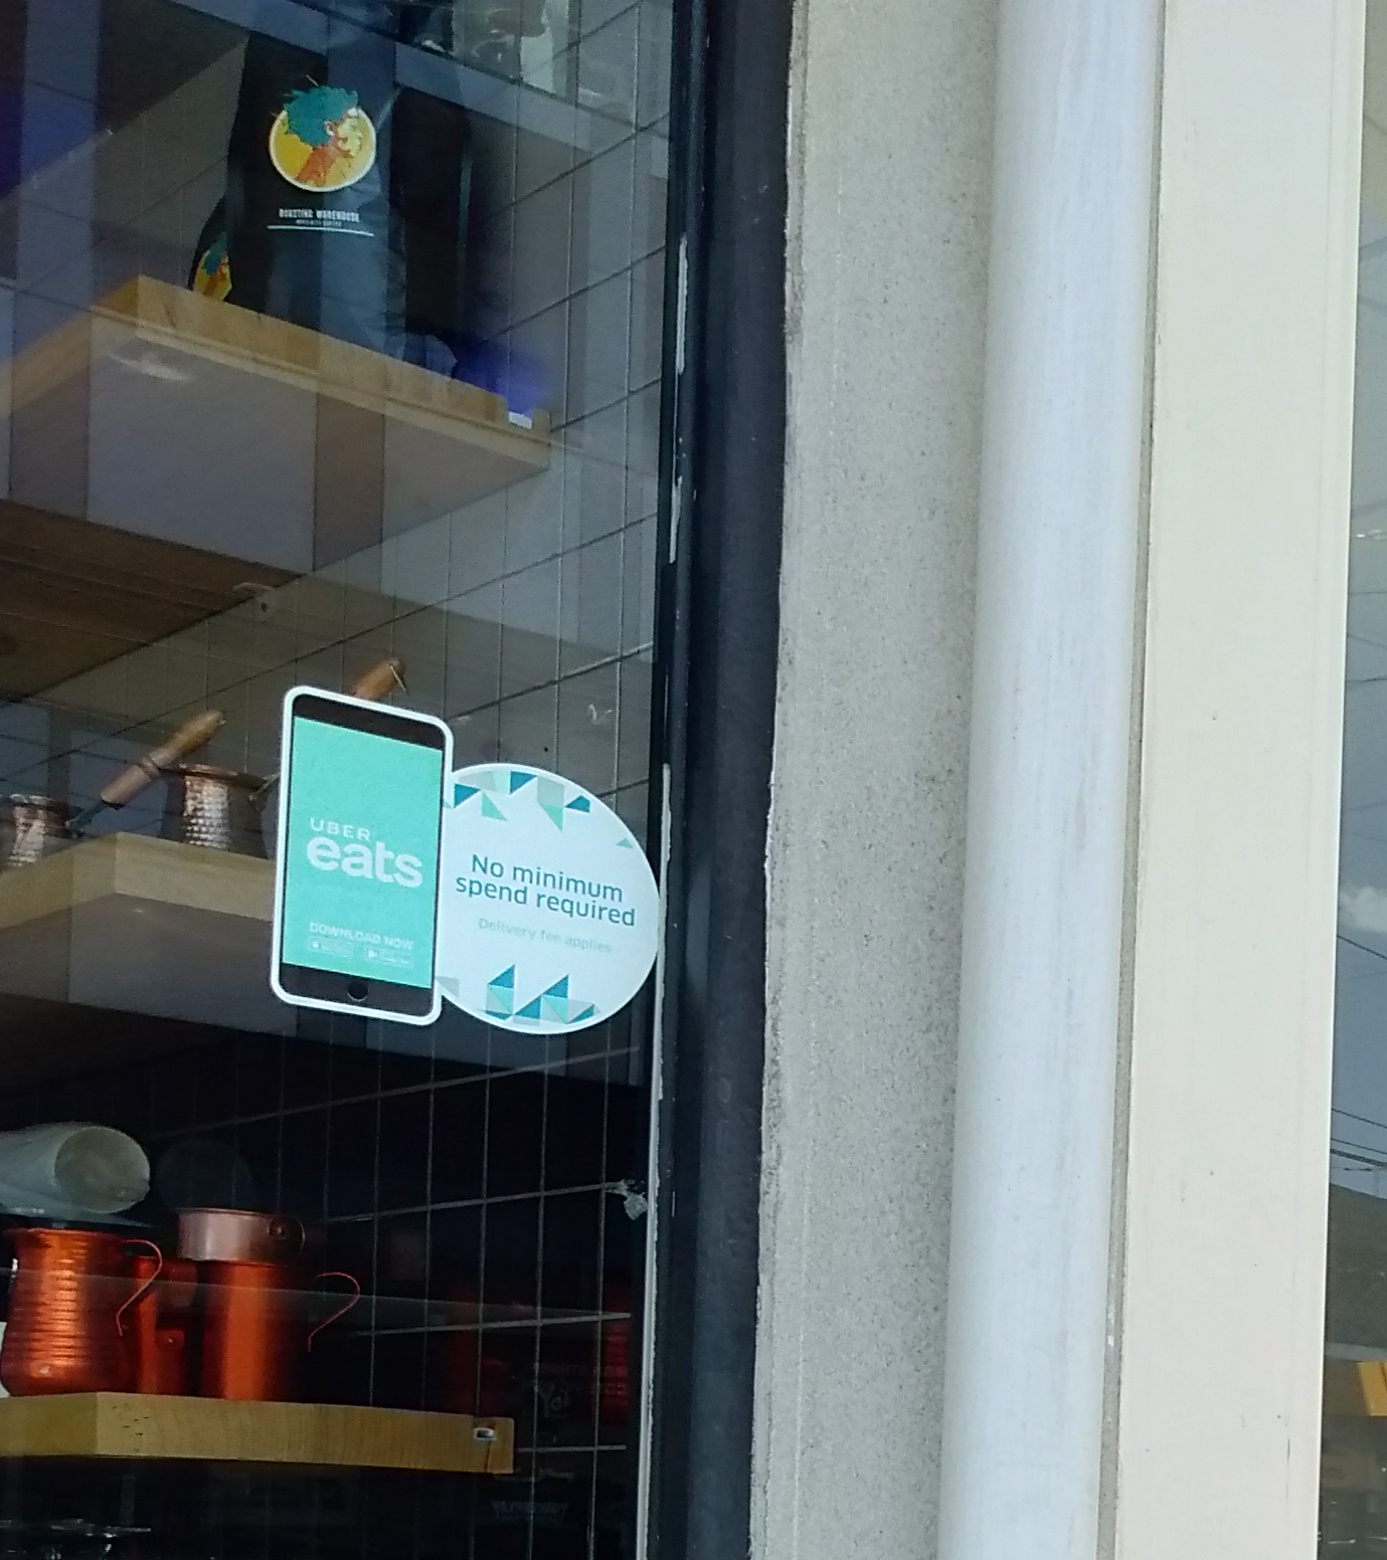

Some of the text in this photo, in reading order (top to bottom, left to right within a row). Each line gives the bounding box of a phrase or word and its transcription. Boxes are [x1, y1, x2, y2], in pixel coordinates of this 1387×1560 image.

[309, 817, 372, 842] UBER
[306, 835, 424, 889] eats
[471, 853, 624, 903] No minimum
[455, 877, 636, 927] spend required
[309, 921, 382, 947] DOWNLOAD
[382, 936, 415, 951] NOW
[478, 917, 613, 955] Delivery fee applies
